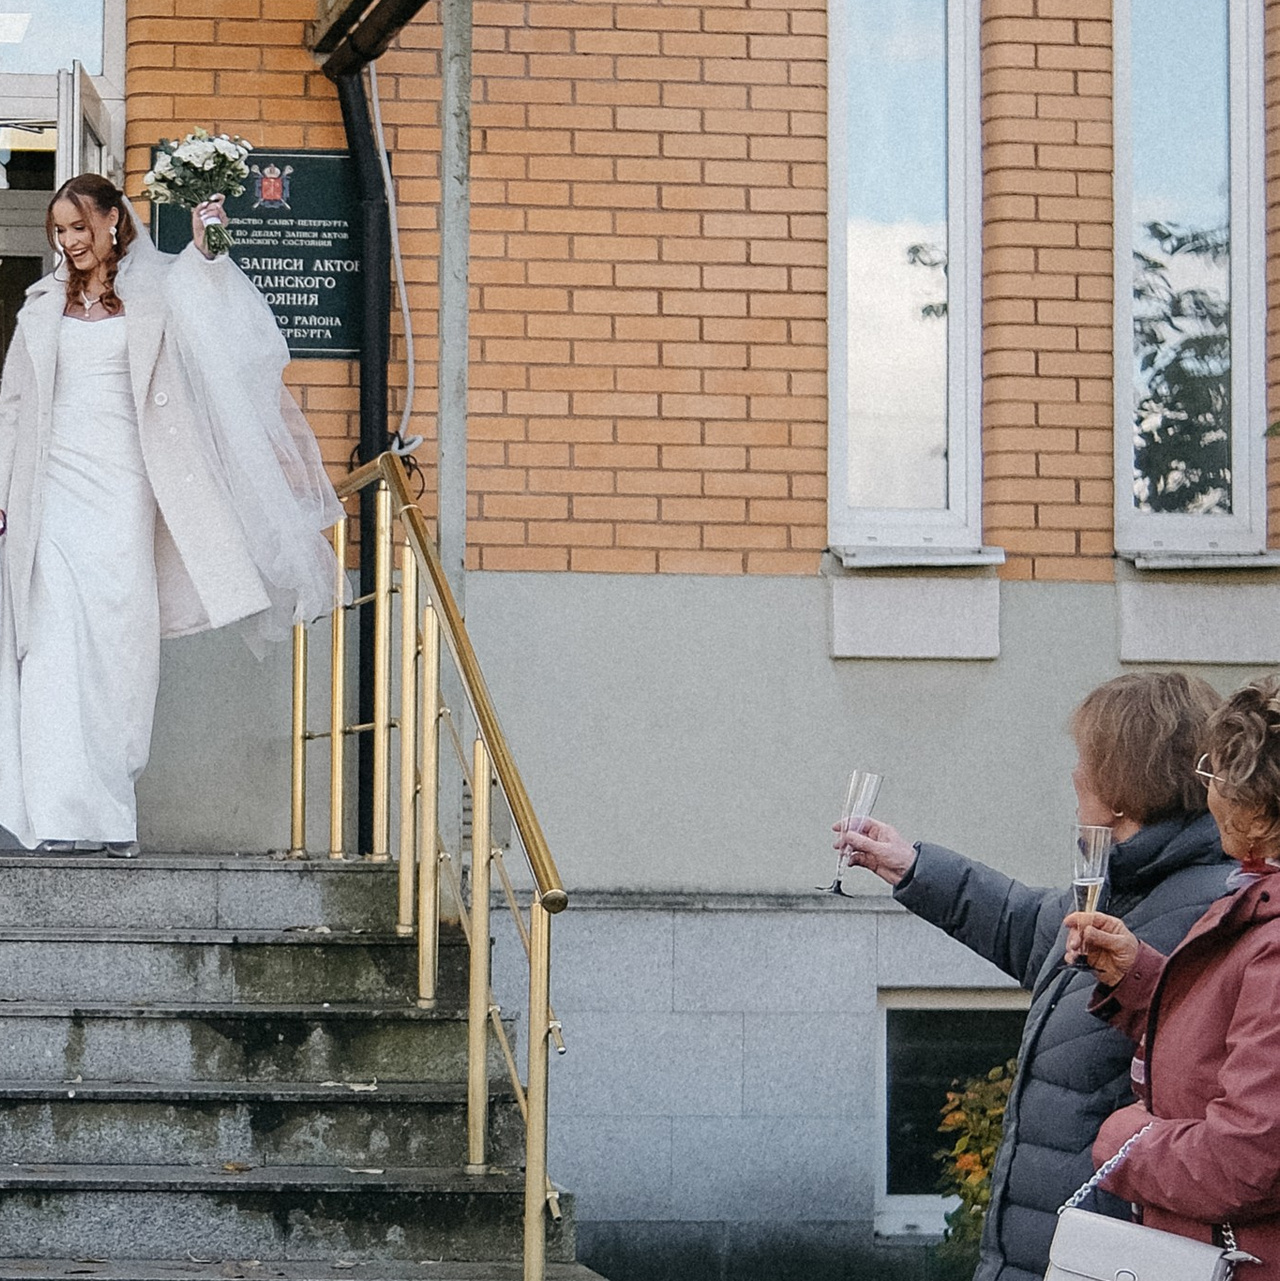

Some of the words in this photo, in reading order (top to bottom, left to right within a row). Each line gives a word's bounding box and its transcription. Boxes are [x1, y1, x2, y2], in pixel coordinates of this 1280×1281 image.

[267, 218, 349, 227] САНКТ-ПЕТЕРБУРГА
[250, 230, 281, 238] ДЕЛАМ
[282, 239, 332, 247] СОСТОЯНИЯ
[240, 257, 304, 271] ЗАПИСИ
[252, 275, 336, 289] ДАНСКОГО
[264, 293, 319, 306] ОЯНИЯ
[294, 315, 342, 326] РАЙОНА
